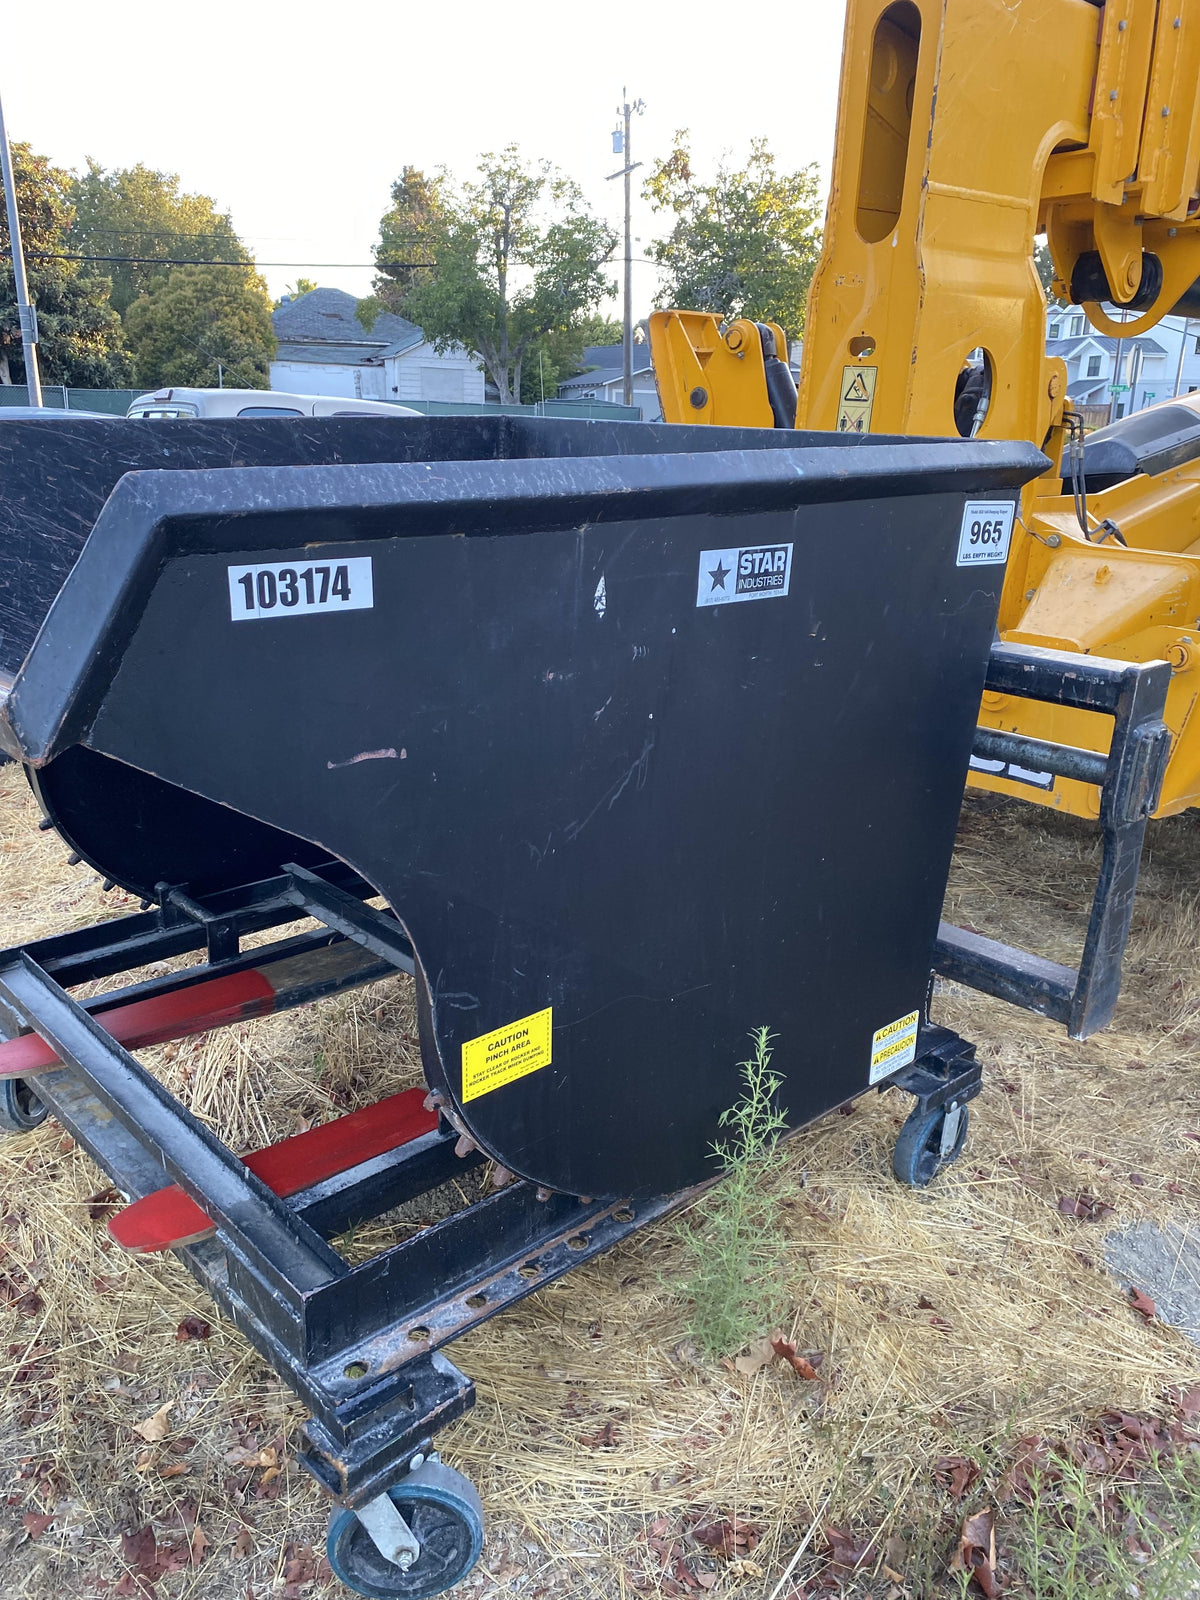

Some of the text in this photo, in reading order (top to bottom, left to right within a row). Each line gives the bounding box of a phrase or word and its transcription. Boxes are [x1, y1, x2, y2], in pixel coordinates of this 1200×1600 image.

[970, 520, 1004, 545] 965
[740, 550, 786, 575] STAR
[237, 565, 352, 610] 103174
[738, 574, 784, 589] INDUSTRIES
[882, 1013, 917, 1038] CAUTION
[485, 1039, 531, 1064] PINCH AREA
[487, 1028, 529, 1052] CAUTION
[468, 1075, 490, 1087] ROCKER
[490, 1067, 507, 1078] TRACK
[507, 1060, 522, 1070] WHEN
[522, 1050, 545, 1063] DUMPING
[472, 1070, 485, 1079] STAY
[486, 1063, 502, 1073] CLEAR
[510, 1052, 530, 1063] ROCKER
[530, 1045, 542, 1053] AND
